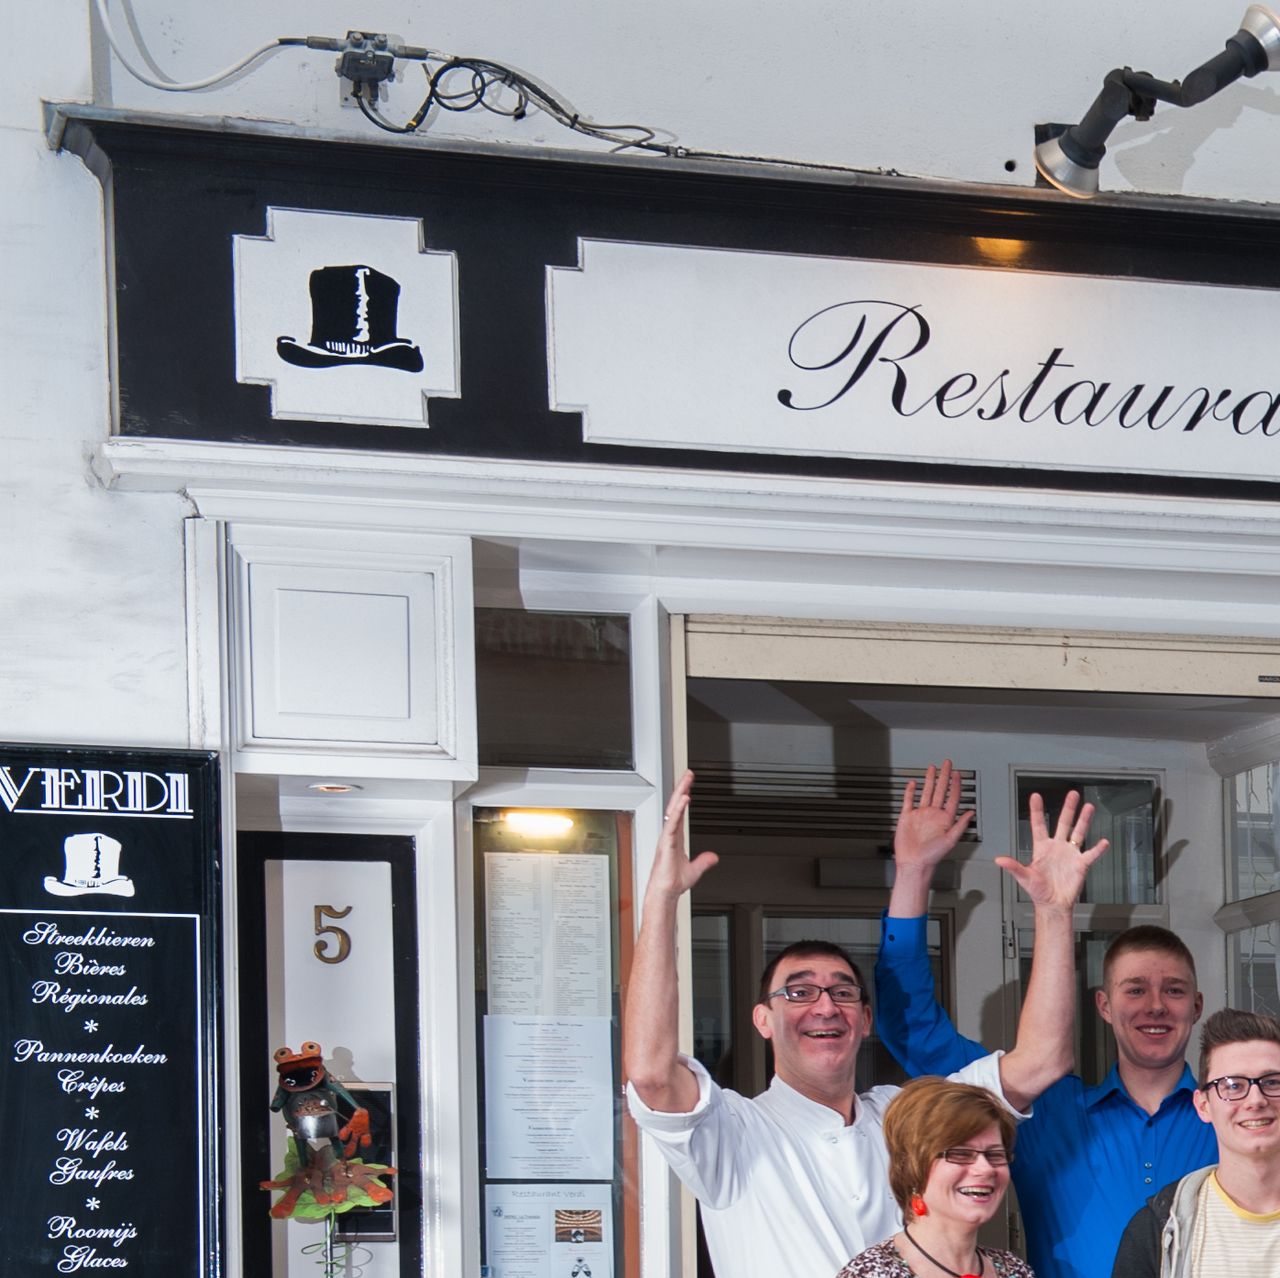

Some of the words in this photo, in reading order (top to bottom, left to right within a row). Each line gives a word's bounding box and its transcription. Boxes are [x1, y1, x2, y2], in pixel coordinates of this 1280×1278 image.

[0, 766, 194, 813] VERDI
[22, 921, 156, 948] Streekbieren
[313, 904, 353, 964] 5
[54, 951, 127, 976] Bières
[31, 980, 149, 1013] Régionales
[14, 1038, 168, 1064] Pannenkoeken
[57, 1069, 127, 1100] Crêpes
[56, 1128, 129, 1158] Wafels
[49, 1156, 135, 1187] Gaufres
[47, 1215, 138, 1248] Roomijs
[57, 1245, 128, 1273] Glaces
